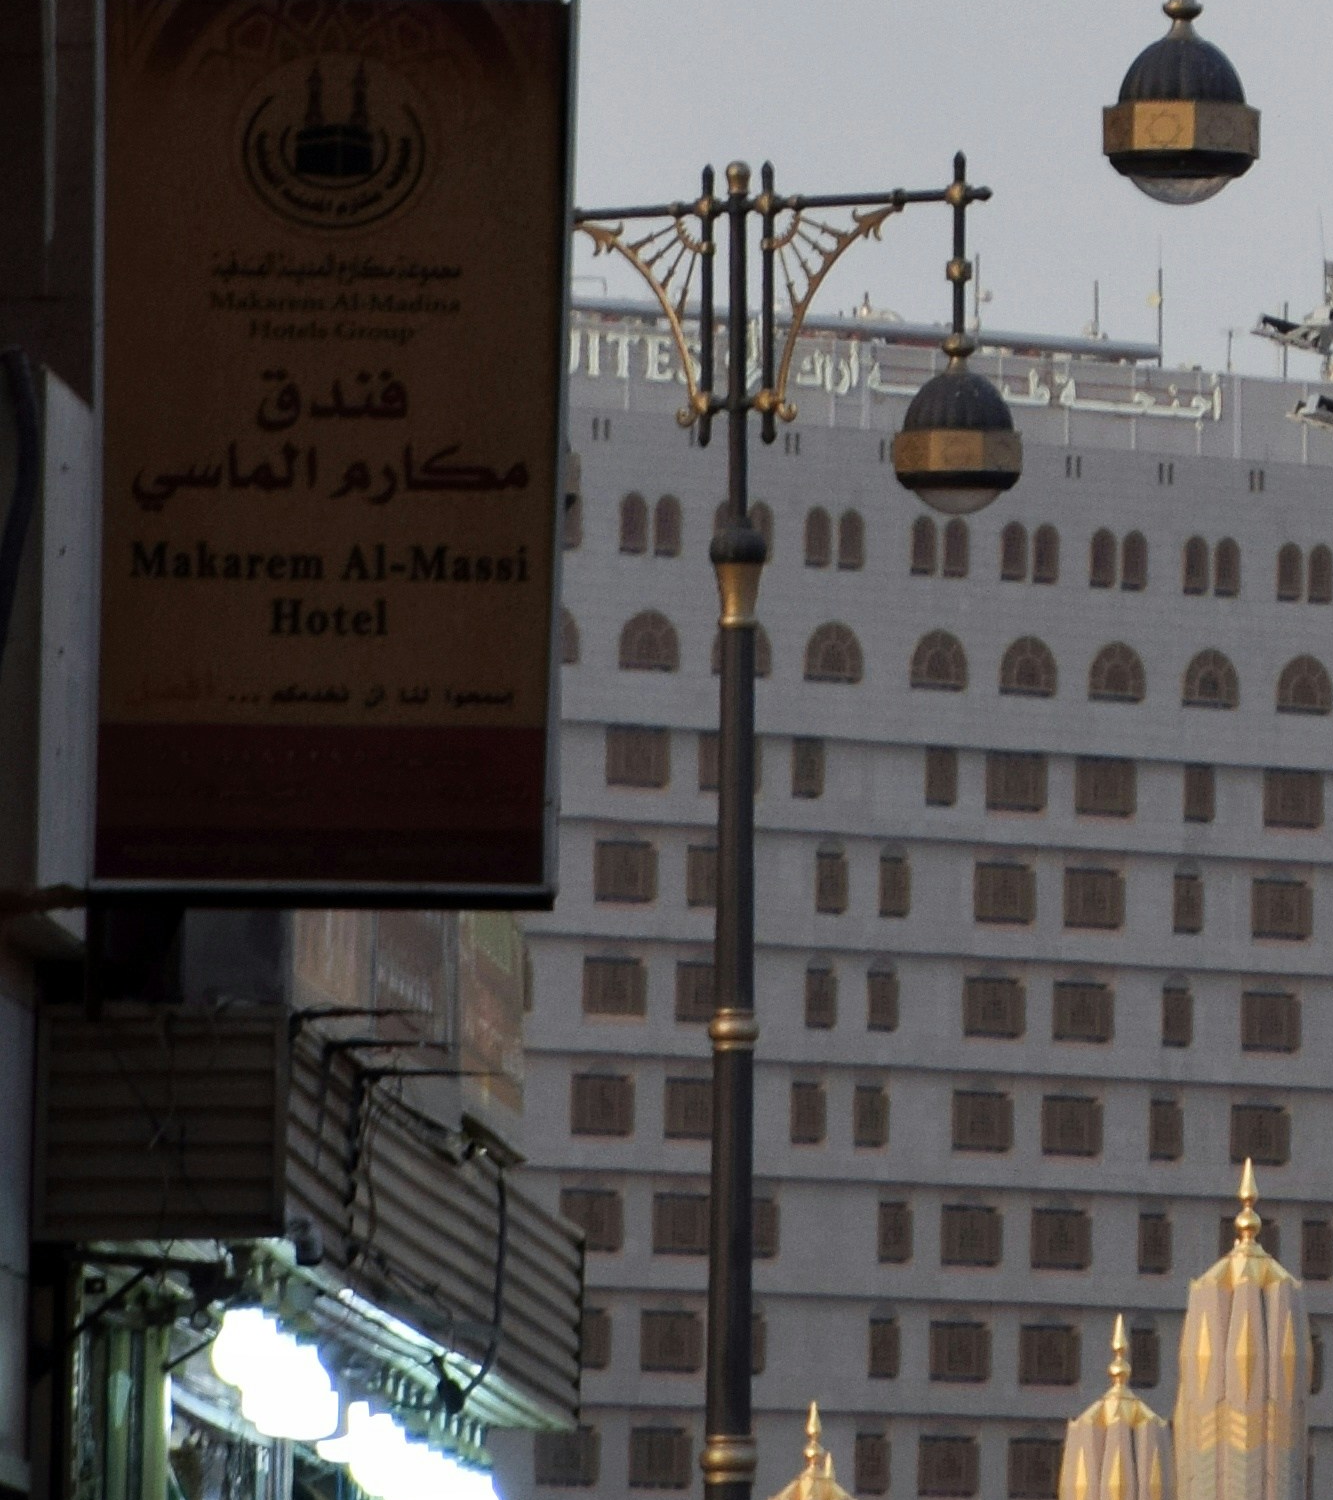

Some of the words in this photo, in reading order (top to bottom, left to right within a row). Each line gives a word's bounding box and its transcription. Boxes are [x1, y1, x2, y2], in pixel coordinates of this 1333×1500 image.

[210, 291, 323, 312] Makarem
[334, 292, 461, 313] Al-Madina
[249, 320, 325, 339] Hotels
[335, 322, 414, 344] Group
[256, 368, 408, 430] فندق
[131, 442, 317, 512] الماسي
[330, 444, 530, 505] مكارم
[130, 541, 324, 581] Makarem
[341, 543, 528, 584] Al-Massi
[270, 598, 389, 636] Hotel
